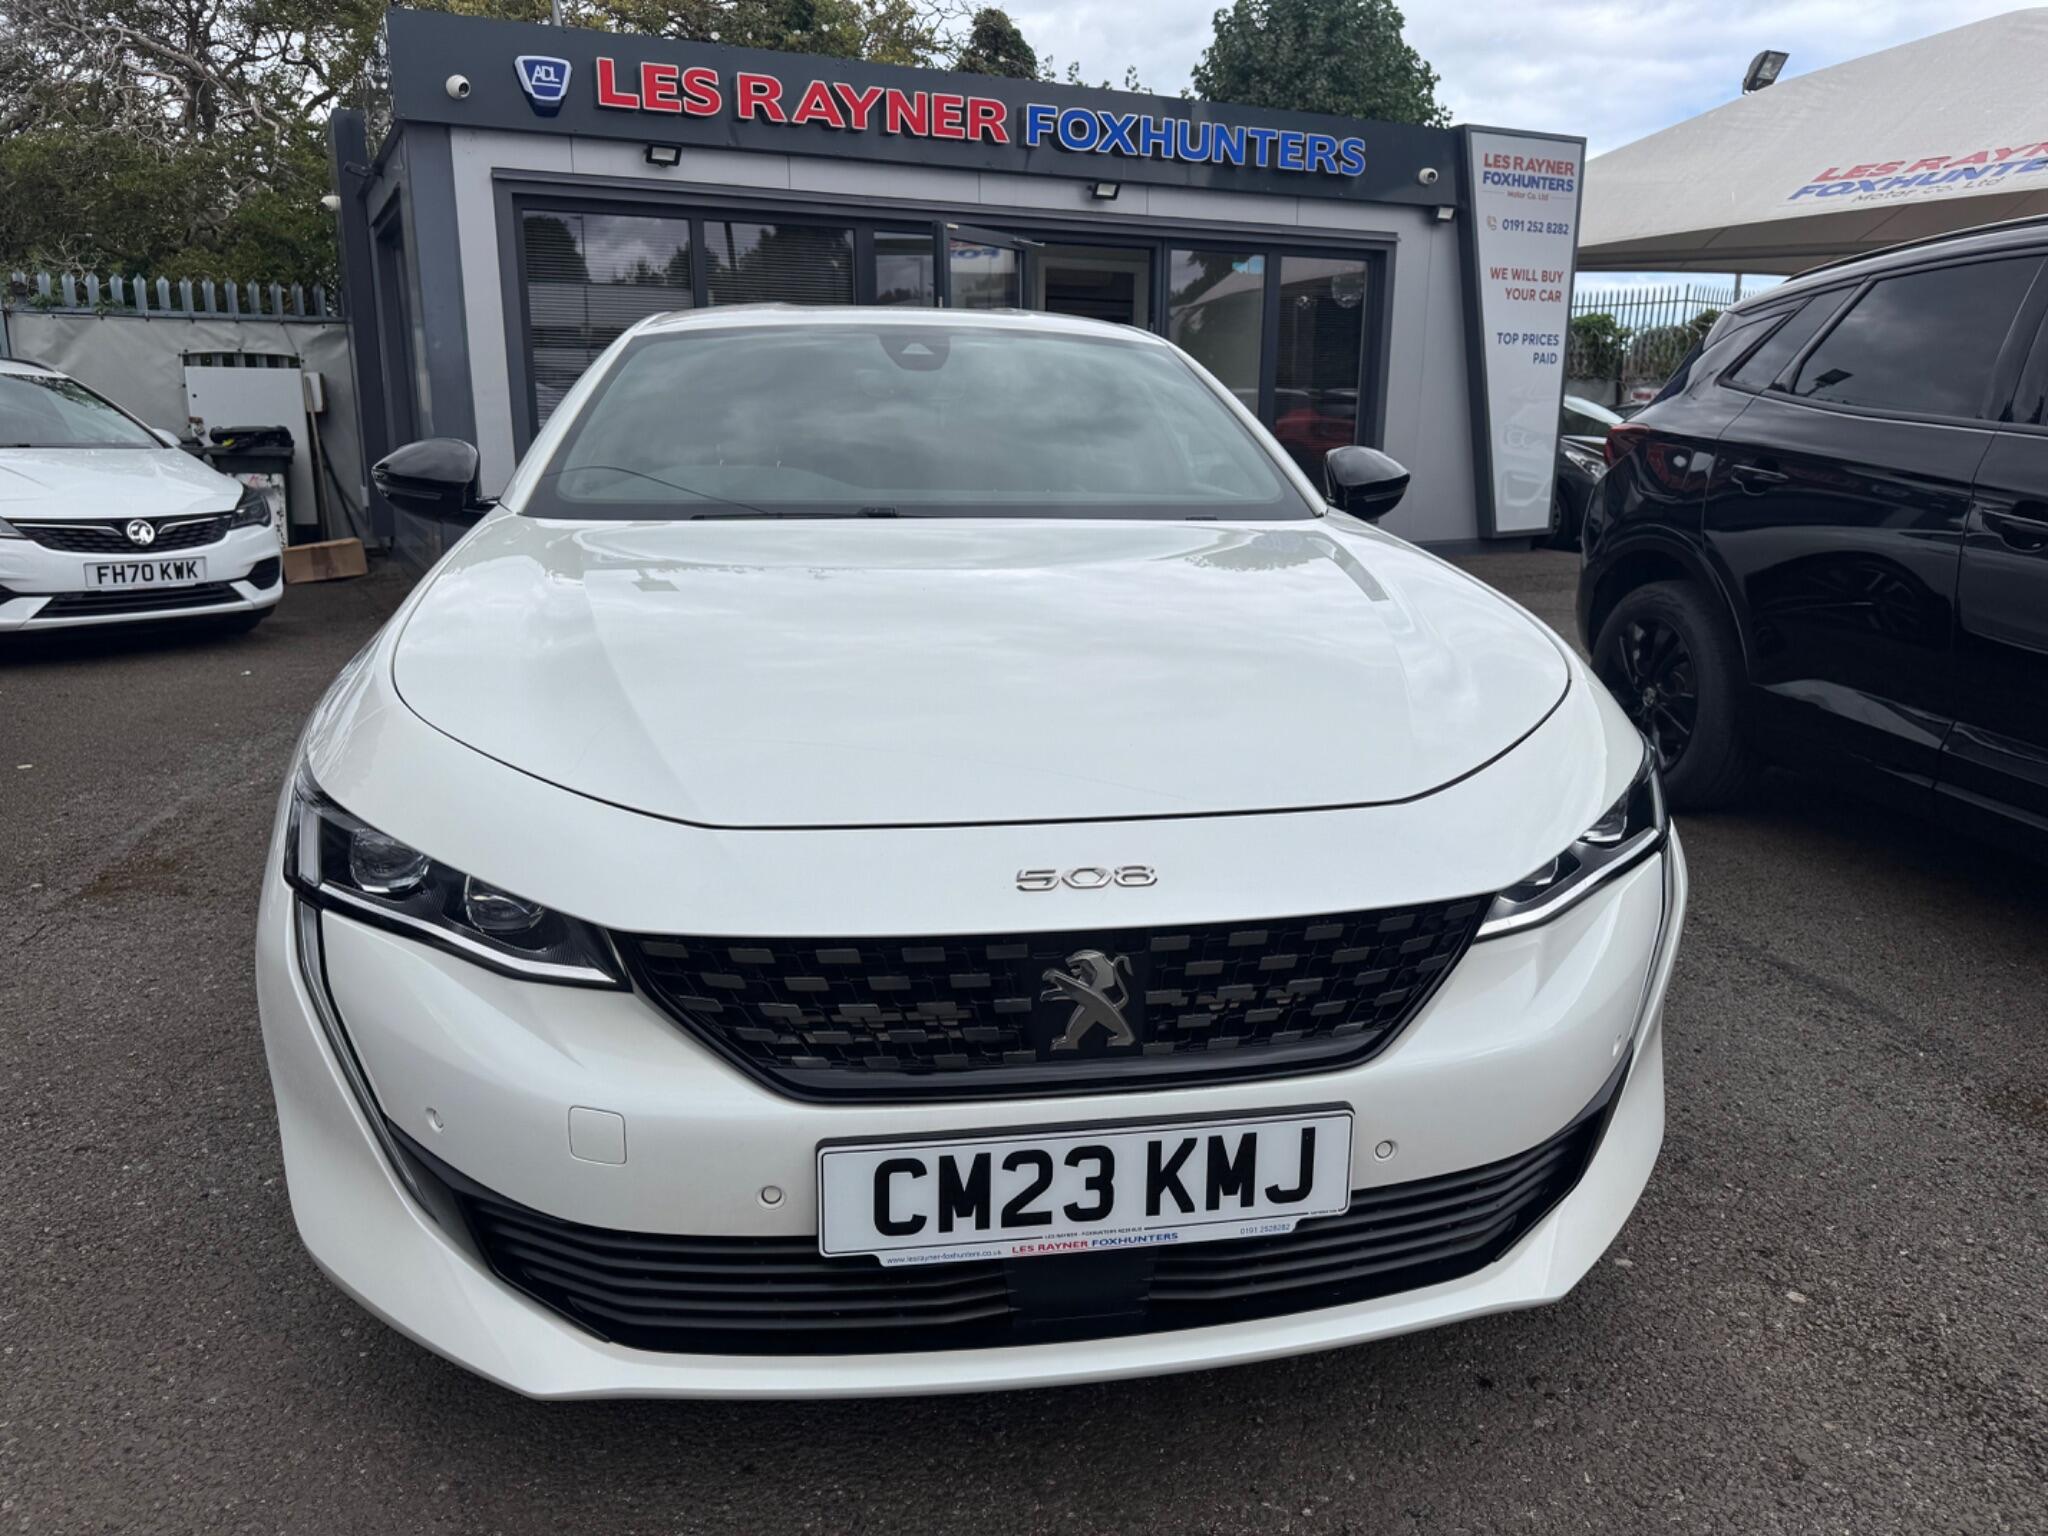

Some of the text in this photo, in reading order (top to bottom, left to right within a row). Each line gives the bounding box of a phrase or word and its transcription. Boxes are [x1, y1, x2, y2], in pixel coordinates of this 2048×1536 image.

[596, 56, 1366, 177] LES RAYNER FOXHUNTERS
[1484, 152, 1575, 177] LES RAYNER
[1811, 160, 1906, 182] LES
[1482, 170, 1574, 193] FOXHUNTERS
[1502, 218, 1569, 235] 0191 252 8282
[1489, 266, 1564, 283] WE WILL BUY
[1505, 287, 1562, 302] YOUR CAR
[1496, 332, 1560, 346] TOP PRICES
[1532, 352, 1558, 365] PAID
[97, 560, 198, 585] FH70 KWK
[1016, 866, 1158, 891] 508
[873, 1126, 1316, 1237] CM23 KMJ
[1011, 1245, 1035, 1255] LES
[1037, 1240, 1089, 1253] RAYNER
[1091, 1232, 1179, 1248] FOXHUNTERS
